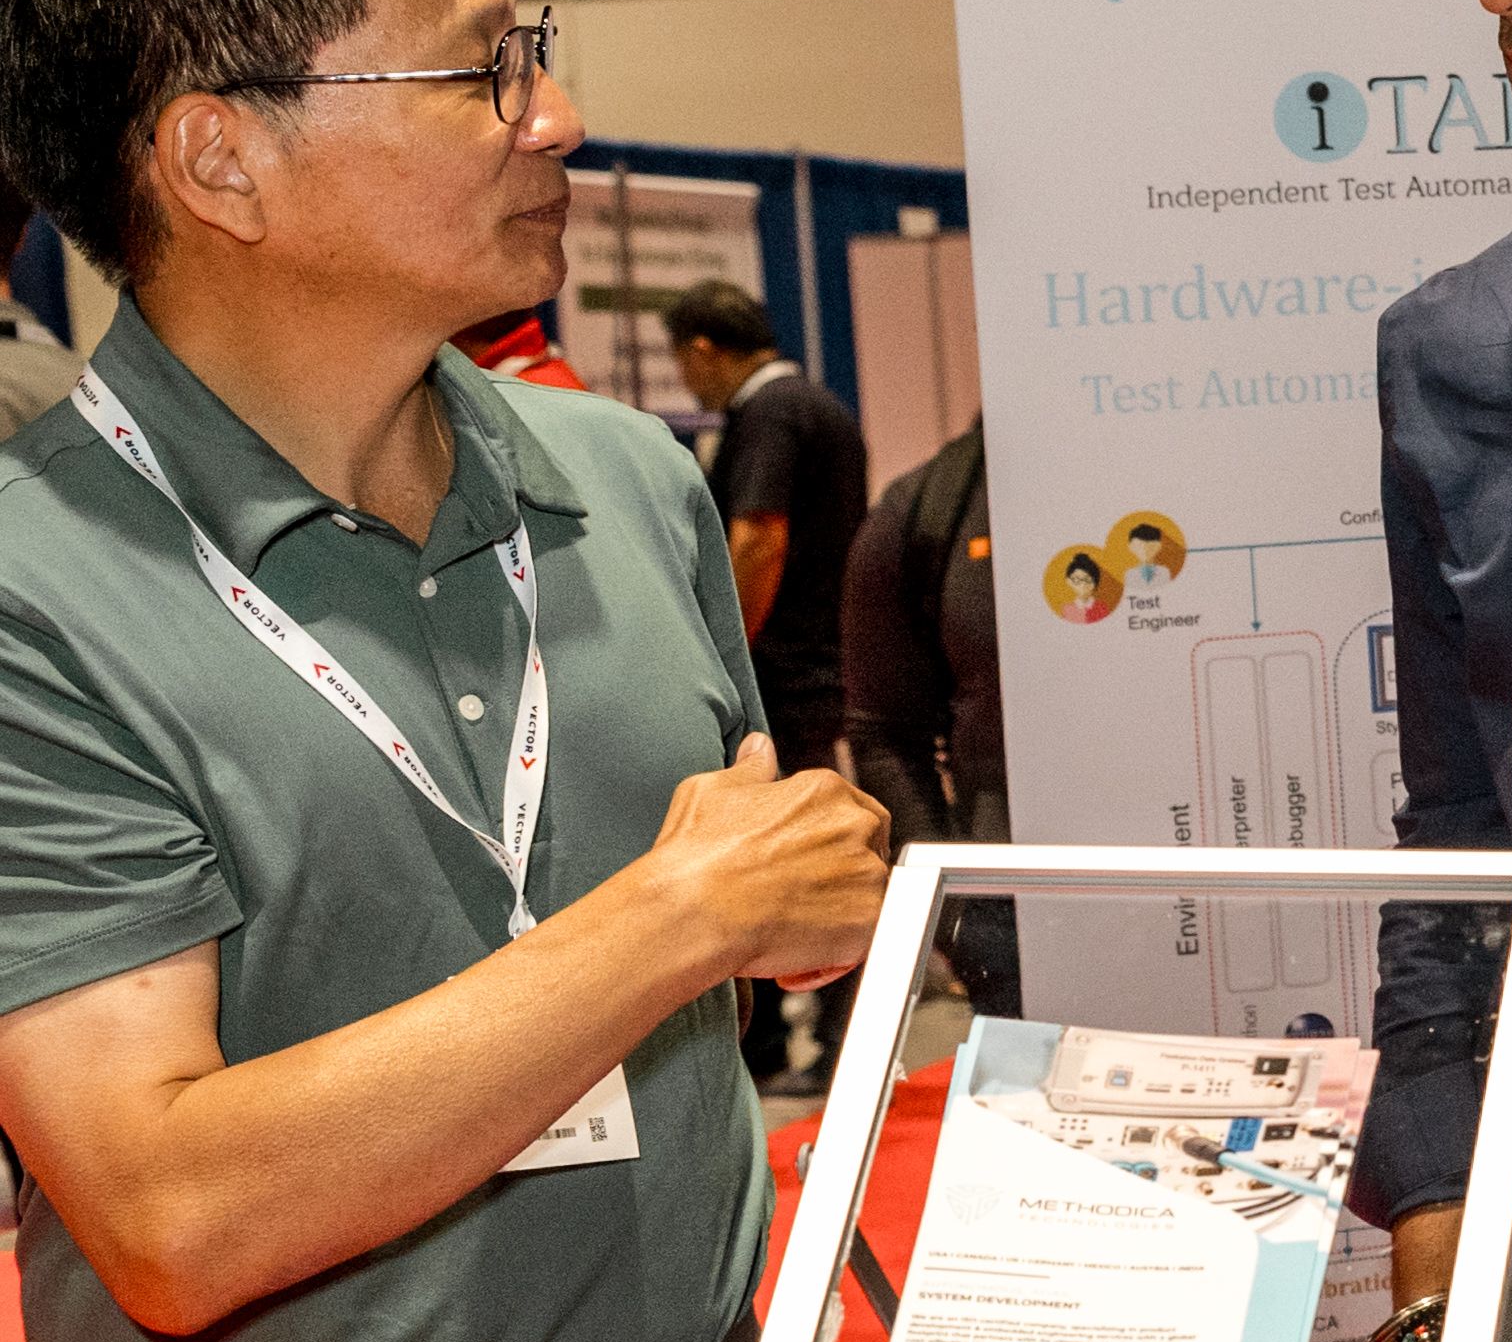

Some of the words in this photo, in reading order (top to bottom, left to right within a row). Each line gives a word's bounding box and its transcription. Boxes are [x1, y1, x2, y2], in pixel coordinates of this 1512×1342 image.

[1147, 180, 1329, 213] Independent
[1338, 177, 1396, 201] Test
[1080, 373, 1183, 414] Test
[244, 599, 286, 641] VECTOR
[1127, 595, 1160, 610] Test
[1128, 613, 1200, 632] Engineer
[327, 675, 367, 718] VECTOR
[525, 704, 538, 754] VECTOR
[513, 803, 527, 855] VECTOR
[1019, 1197, 1175, 1218] METHODICA
[919, 1291, 972, 1302] SYSTEM
[976, 1294, 1081, 1309] DEVELOPMENT
